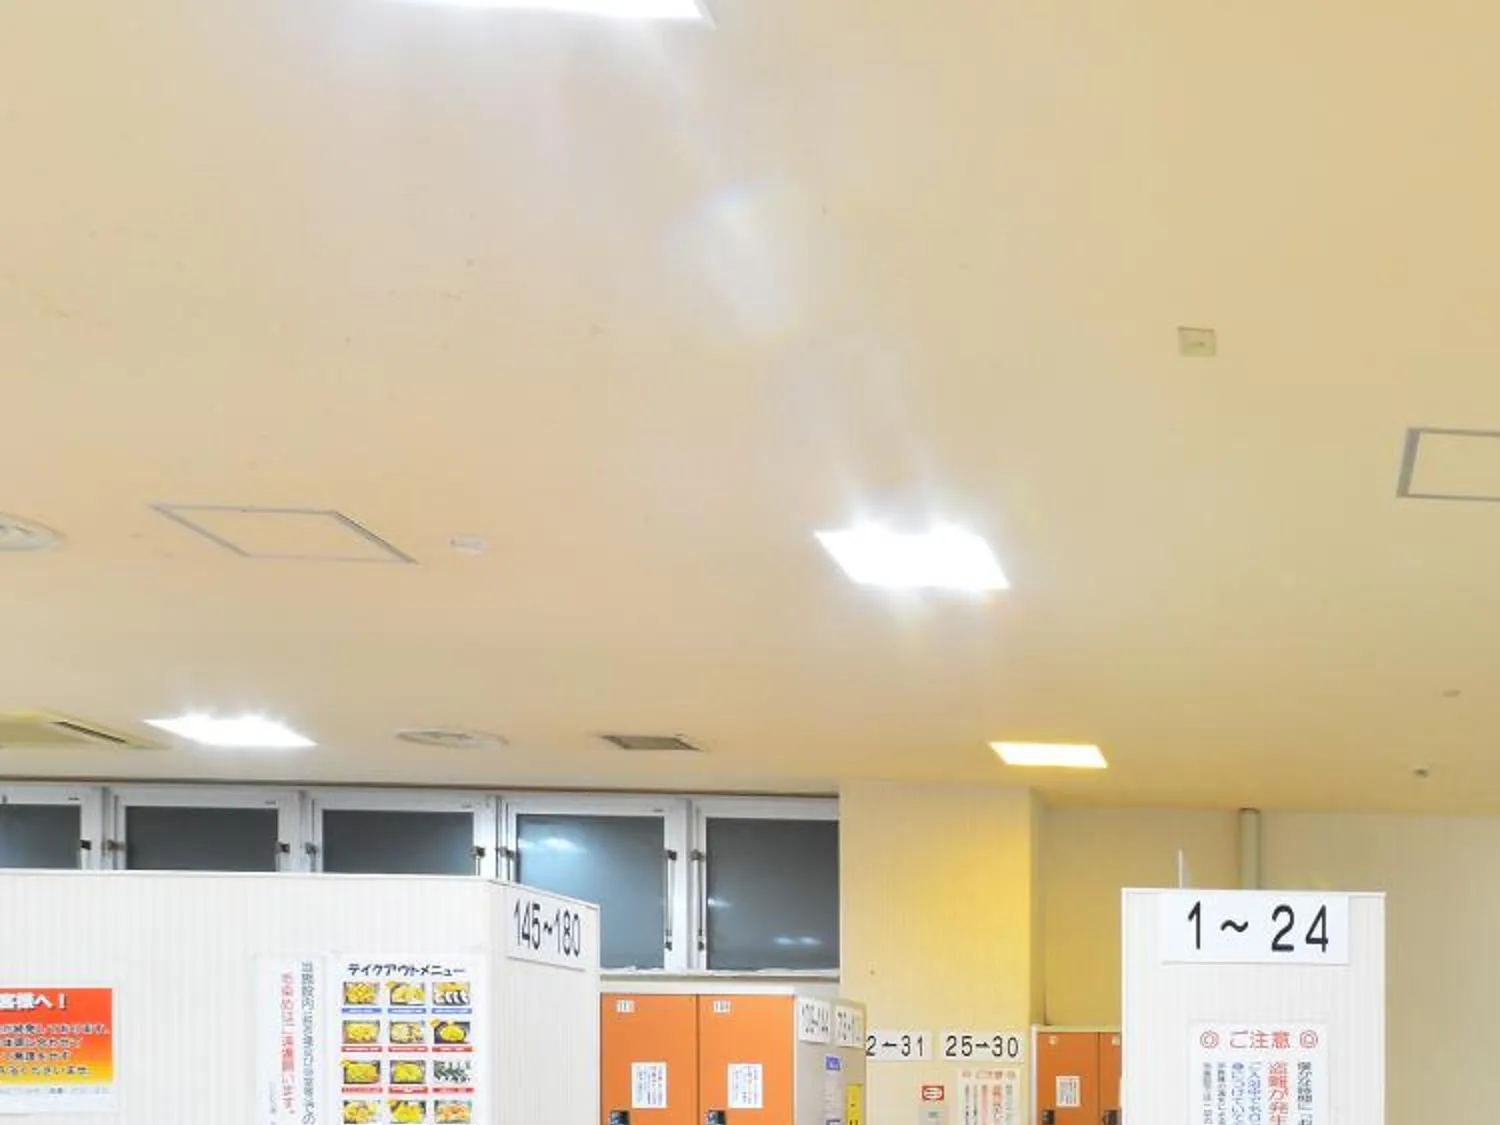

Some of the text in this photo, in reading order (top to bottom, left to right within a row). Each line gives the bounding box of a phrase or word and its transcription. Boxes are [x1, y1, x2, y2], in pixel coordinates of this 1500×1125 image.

[347, 963, 466, 977] テイクアウトメニュー
